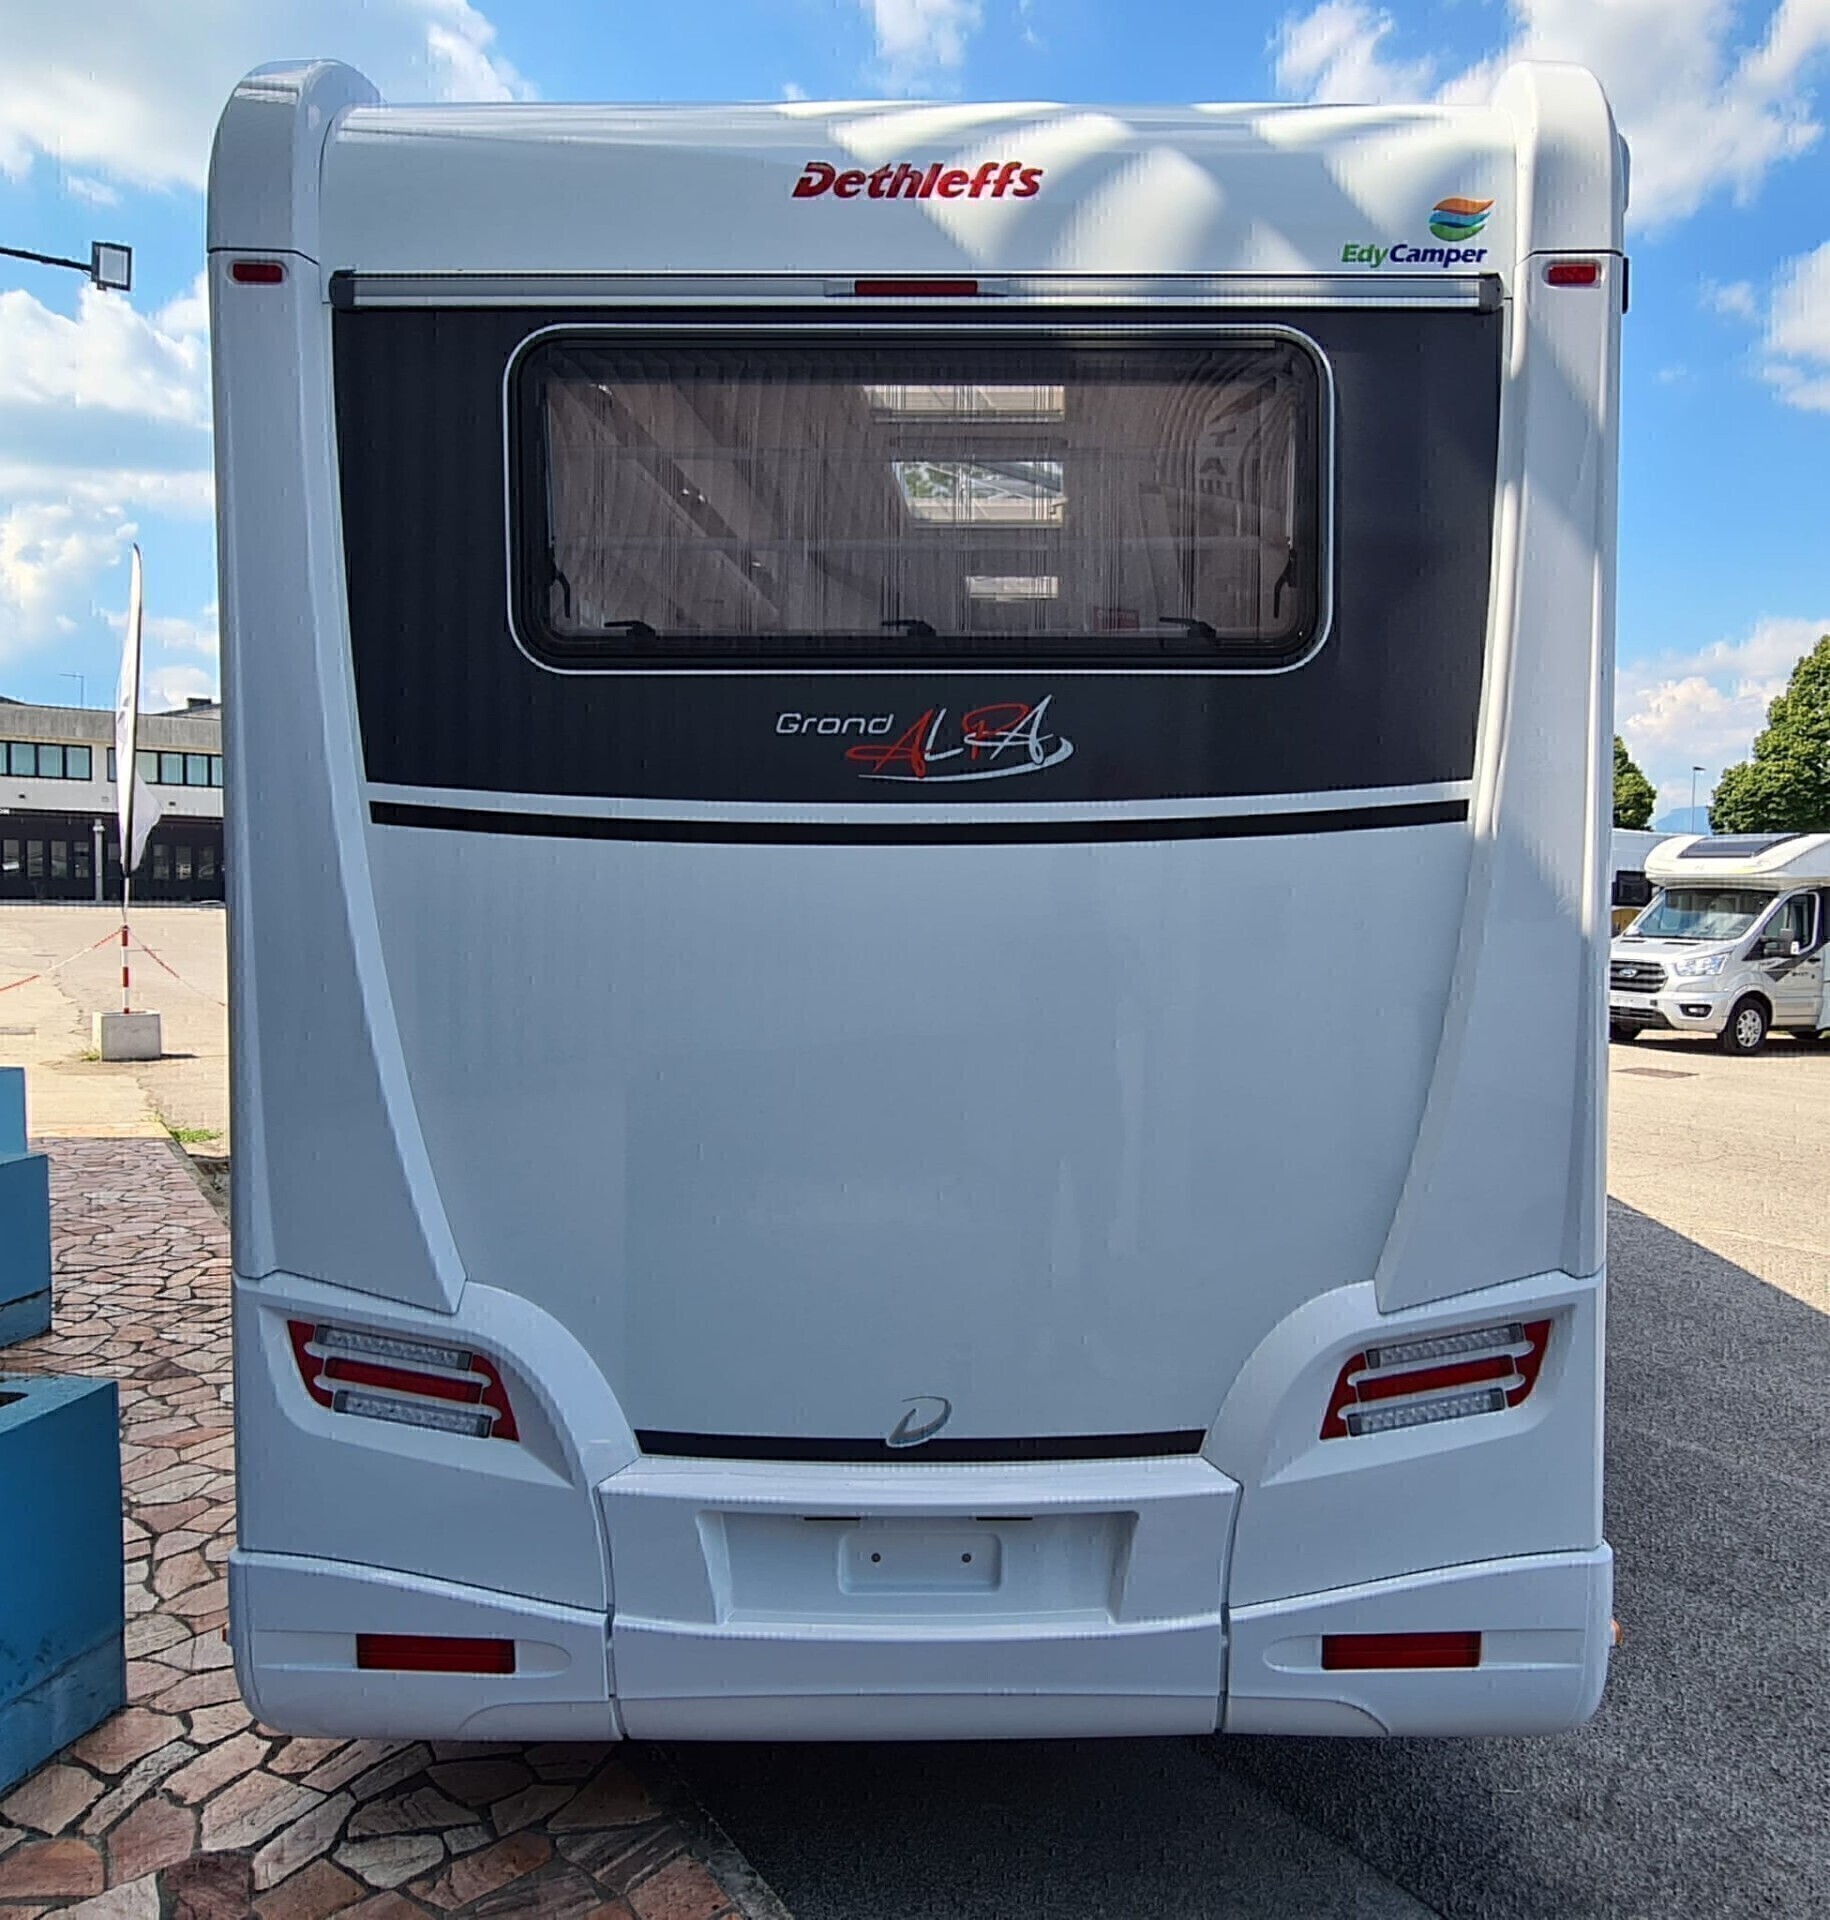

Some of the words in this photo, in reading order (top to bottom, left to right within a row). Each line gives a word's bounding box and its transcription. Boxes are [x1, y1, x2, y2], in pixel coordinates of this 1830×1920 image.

[792, 161, 1043, 199] Dethleffs
[775, 713, 894, 735] Grand
[845, 694, 1055, 778] ALPA
